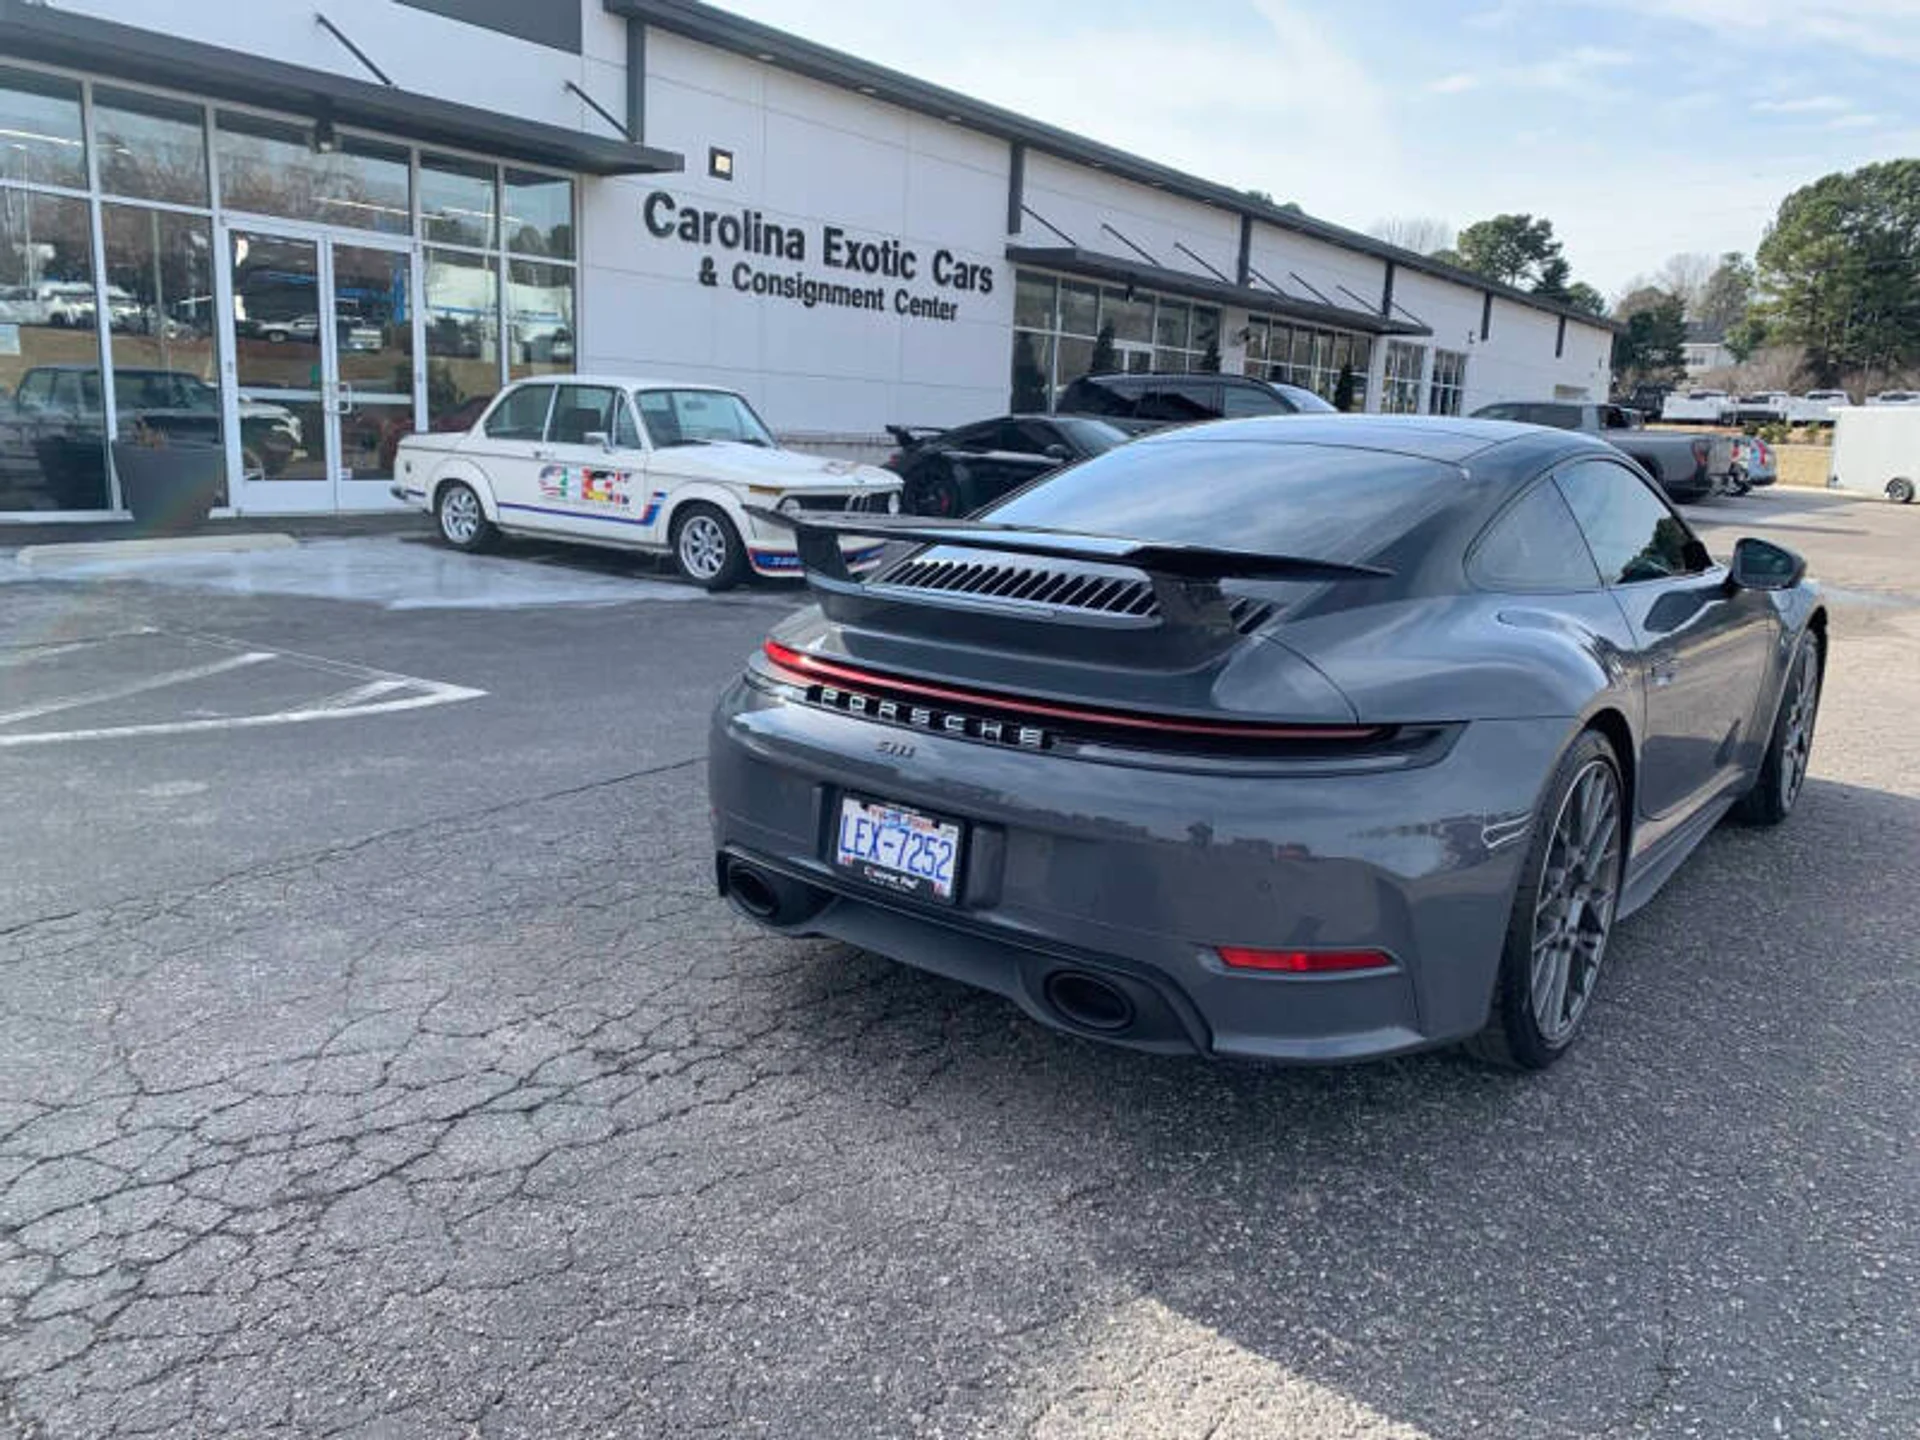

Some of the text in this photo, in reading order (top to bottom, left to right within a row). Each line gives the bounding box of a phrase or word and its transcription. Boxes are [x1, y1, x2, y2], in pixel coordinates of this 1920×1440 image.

[643, 190, 994, 295] Carolina Exotic Cars
[698, 255, 959, 322] & Consignment Center
[821, 686, 1044, 747] PORSCHE
[840, 813, 953, 882] LEX-7252
